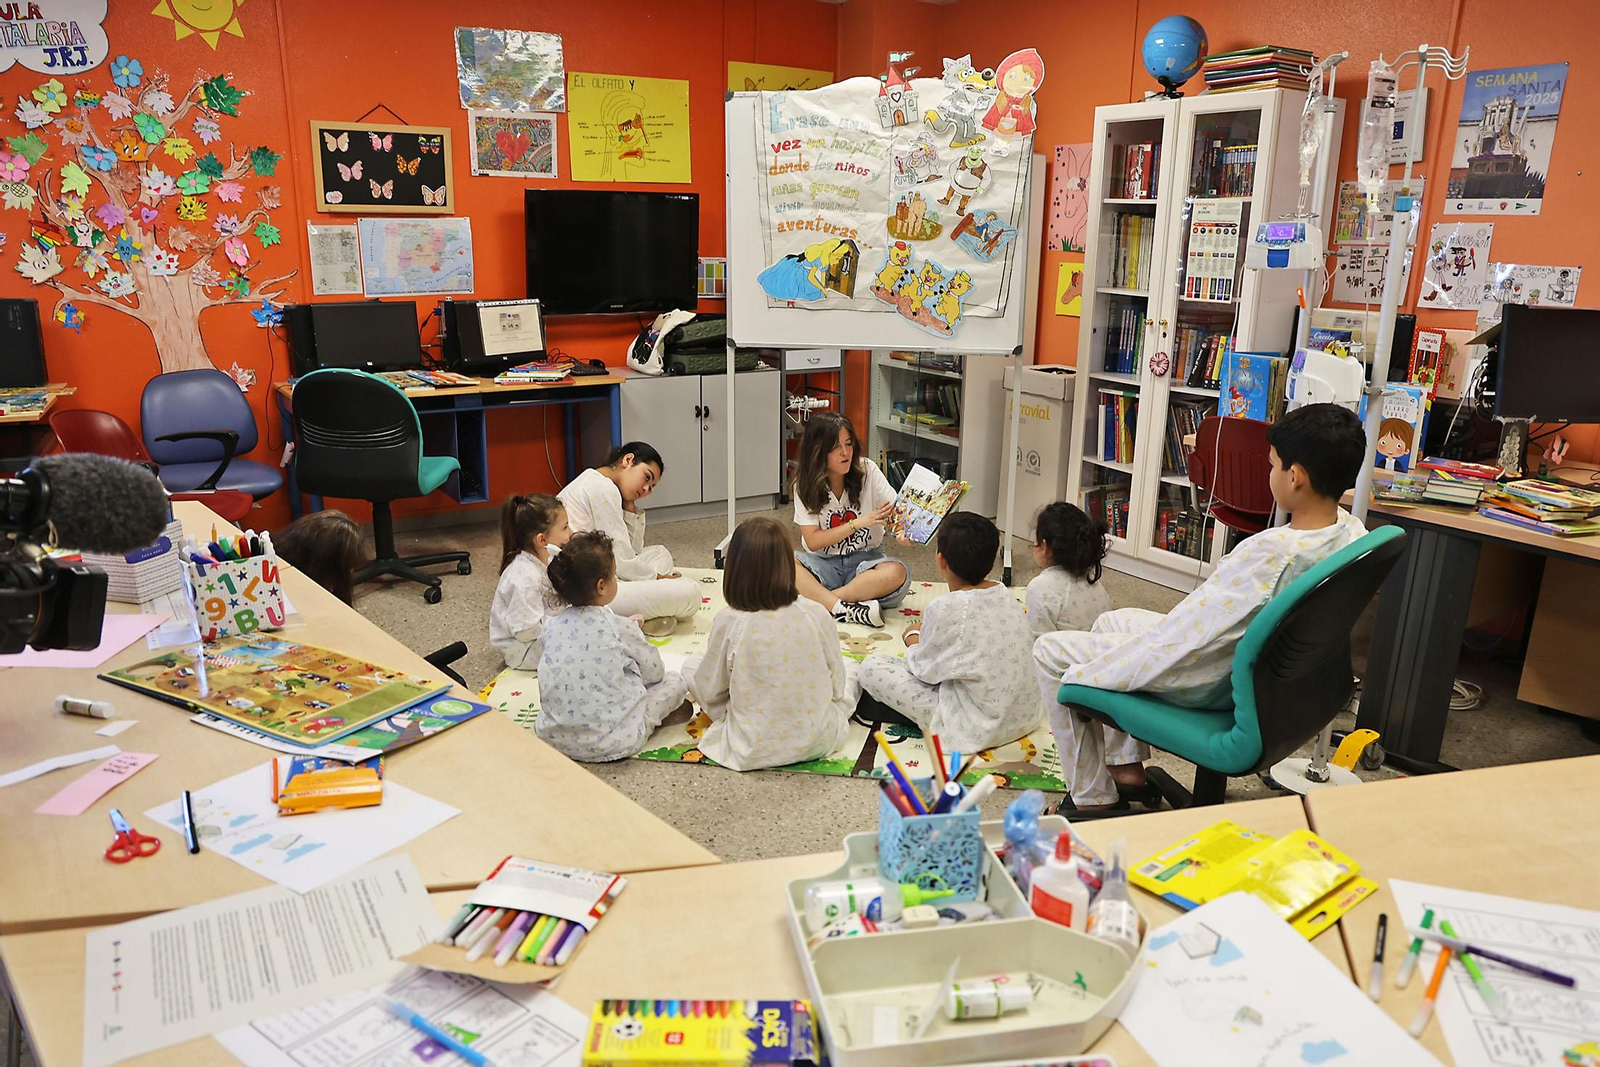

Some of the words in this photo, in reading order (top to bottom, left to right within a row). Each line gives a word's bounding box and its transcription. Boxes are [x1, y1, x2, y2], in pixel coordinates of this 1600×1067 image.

[574, 74, 586, 88] EL
[591, 77, 624, 90] OLFATO
[1475, 71, 1538, 88] SEMANA
[1507, 80, 1562, 97] SANTA
[1524, 91, 1560, 106] 2025
[771, 139, 802, 154] vez
[806, 138, 827, 149] un
[768, 153, 811, 176] donde
[1239, 357, 1251, 370] 12
[1384, 404, 1410, 413] ALVARO
[204, 597, 227, 622] 9
[233, 608, 260, 633] B
